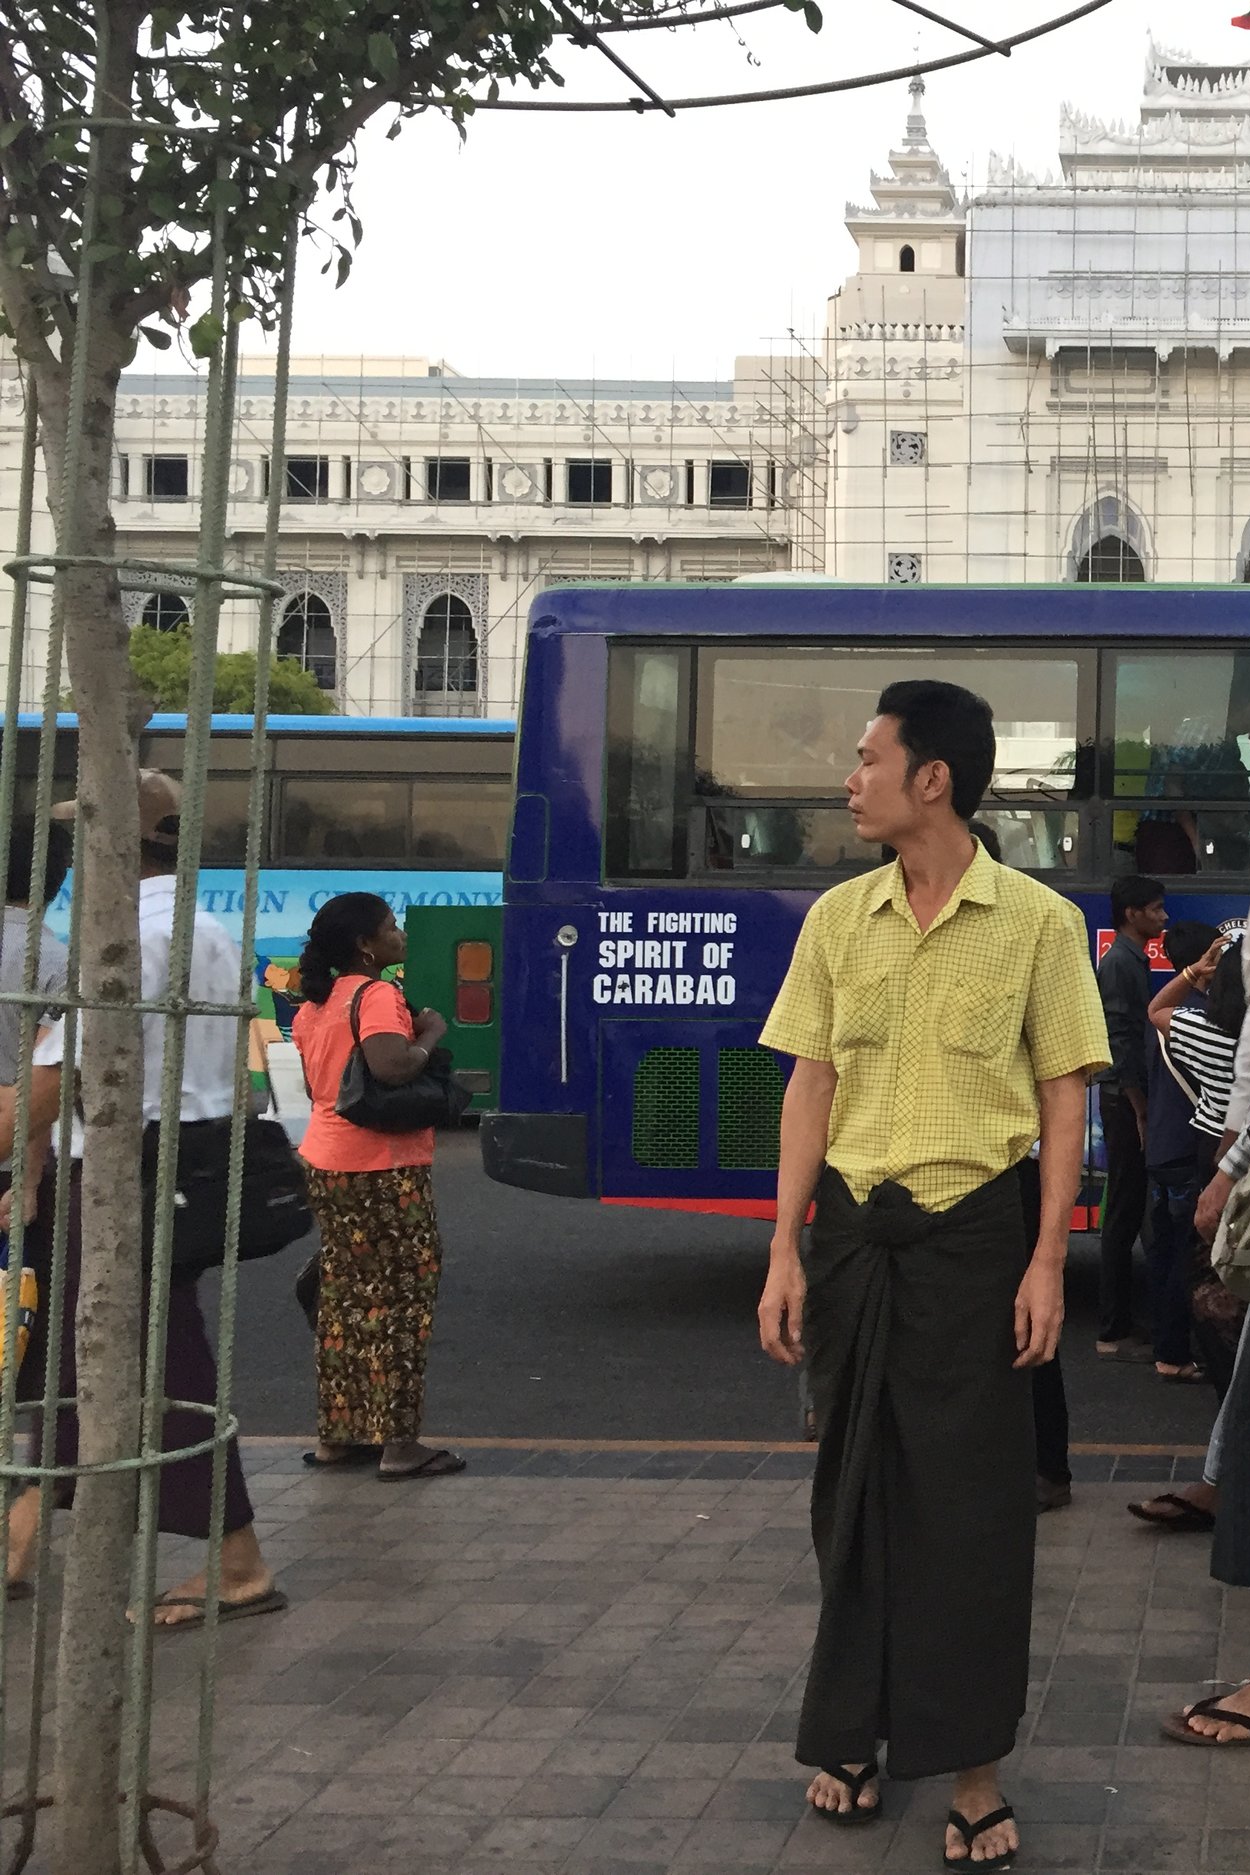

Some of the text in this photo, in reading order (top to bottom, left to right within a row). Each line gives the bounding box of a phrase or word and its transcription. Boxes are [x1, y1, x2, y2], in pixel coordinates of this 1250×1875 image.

[308, 890, 502, 913] CEMONY
[598, 912, 737, 934] THE FIGHTING
[1218, 920, 1248, 934] CHELS
[599, 940, 734, 969] SPIRIT OF
[593, 974, 736, 1005] CARABAO
